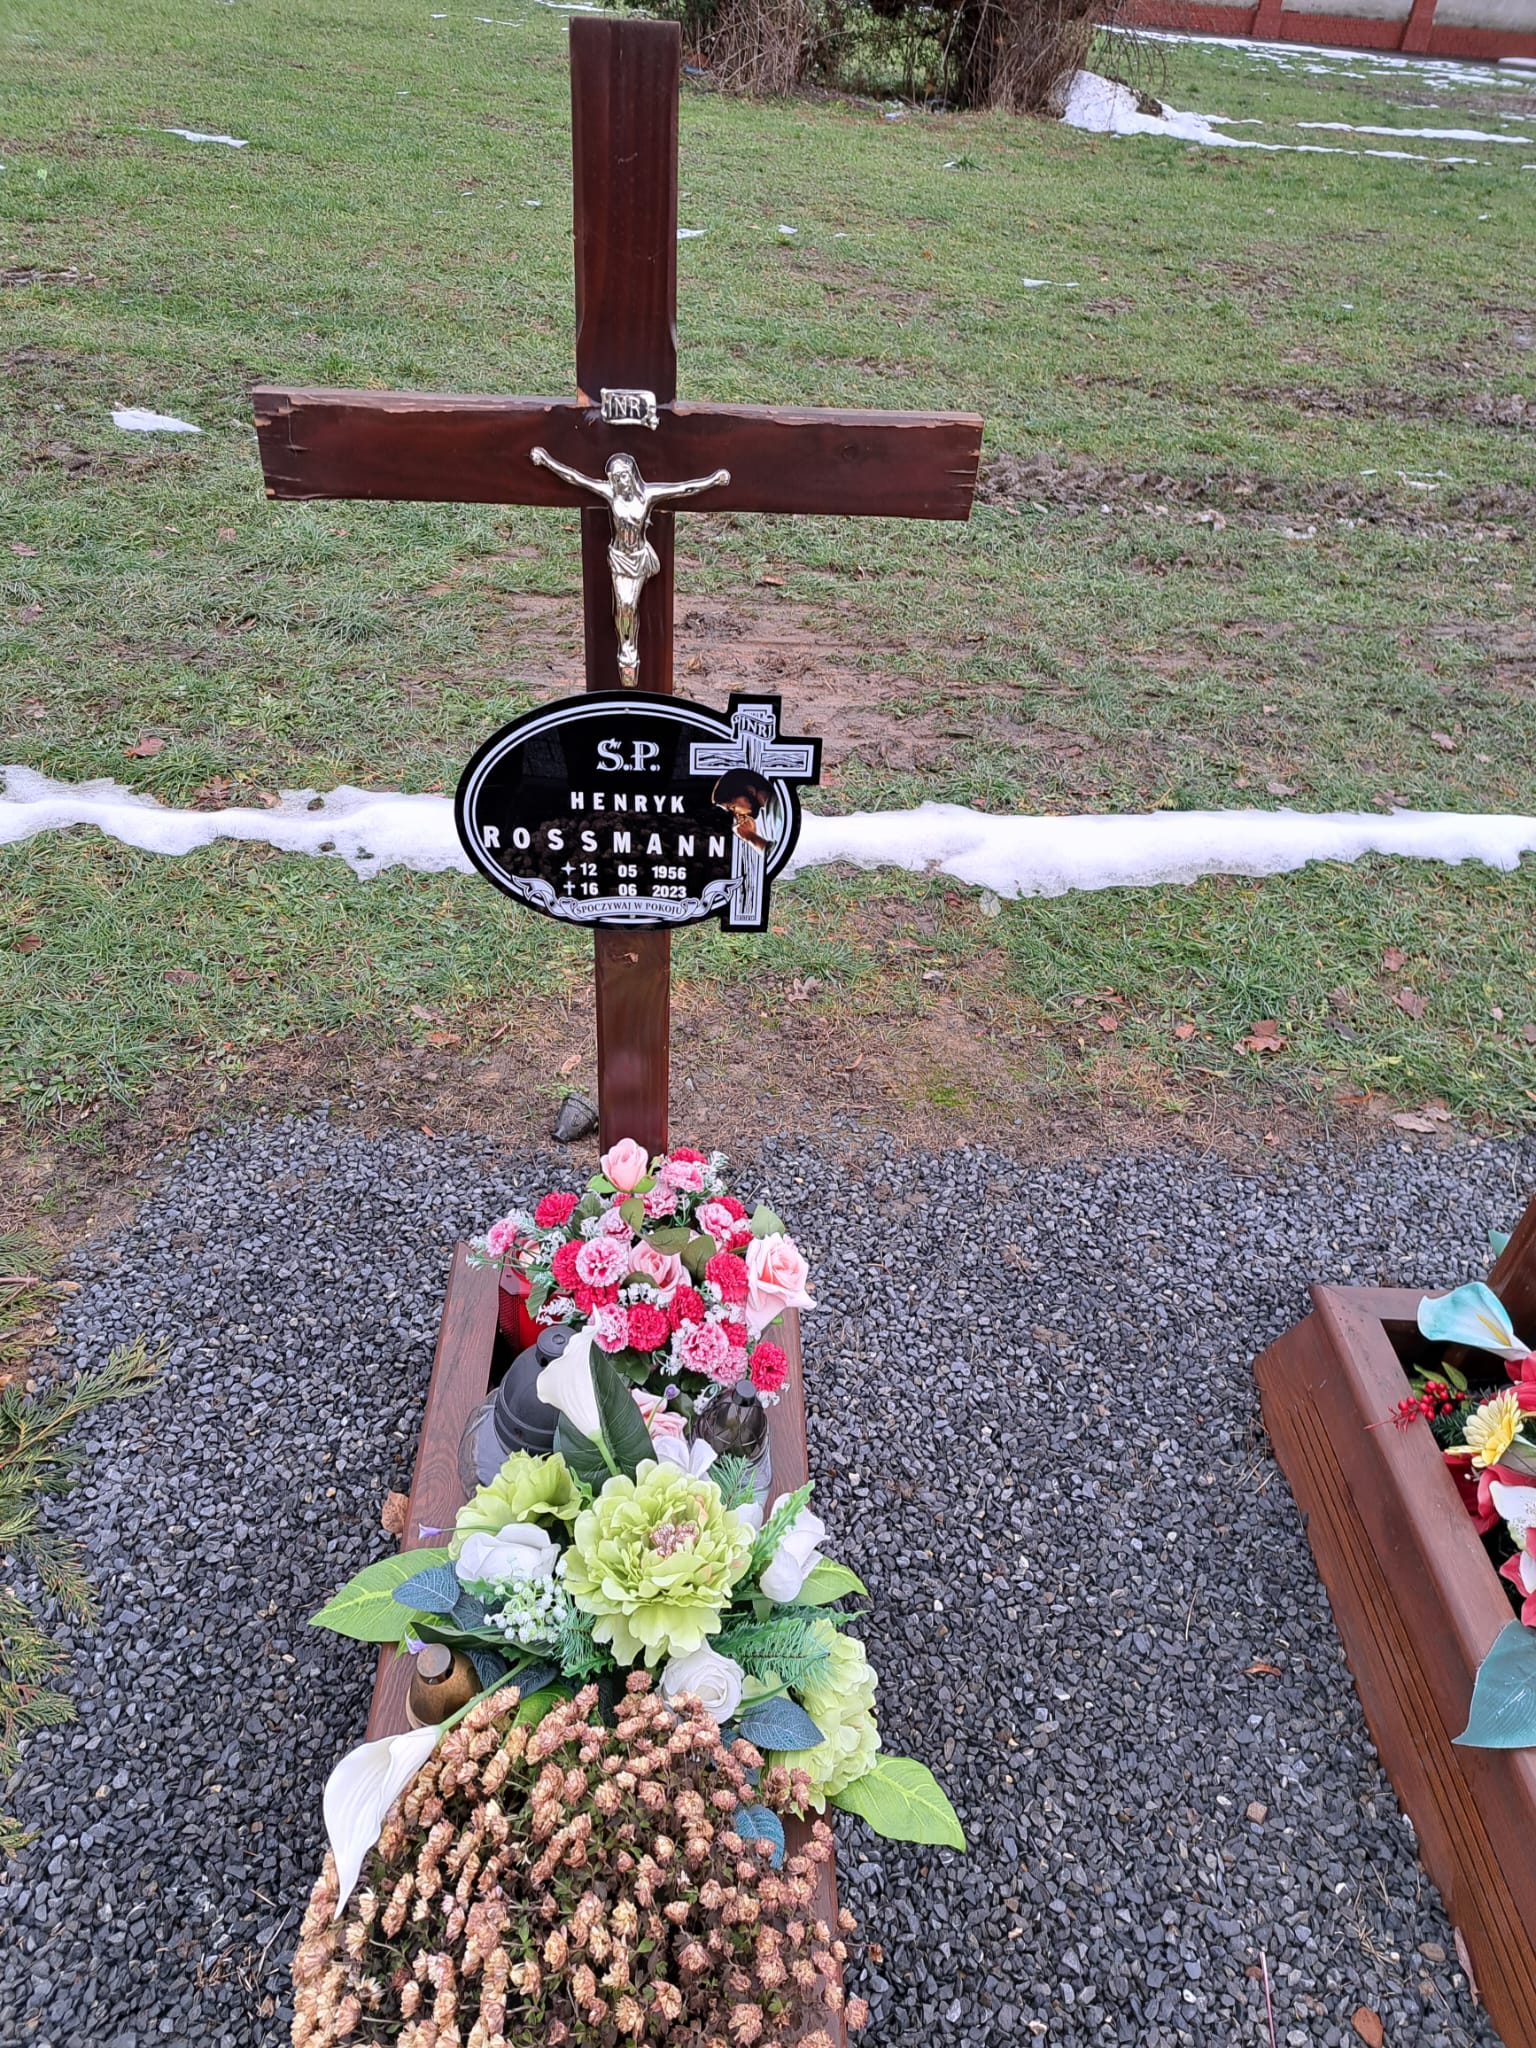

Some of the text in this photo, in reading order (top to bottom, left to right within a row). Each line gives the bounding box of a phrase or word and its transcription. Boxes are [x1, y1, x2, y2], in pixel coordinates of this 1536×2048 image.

[741, 714, 772, 739] INRI
[570, 791, 685, 814] HENRYK
[483, 826, 725, 858] ROSSMANN
[580, 862, 687, 880] 12 05 1956
[580, 882, 687, 899] 16 06 2023
[576, 901, 682, 914] SPOCZYWAJ W POKOJU
